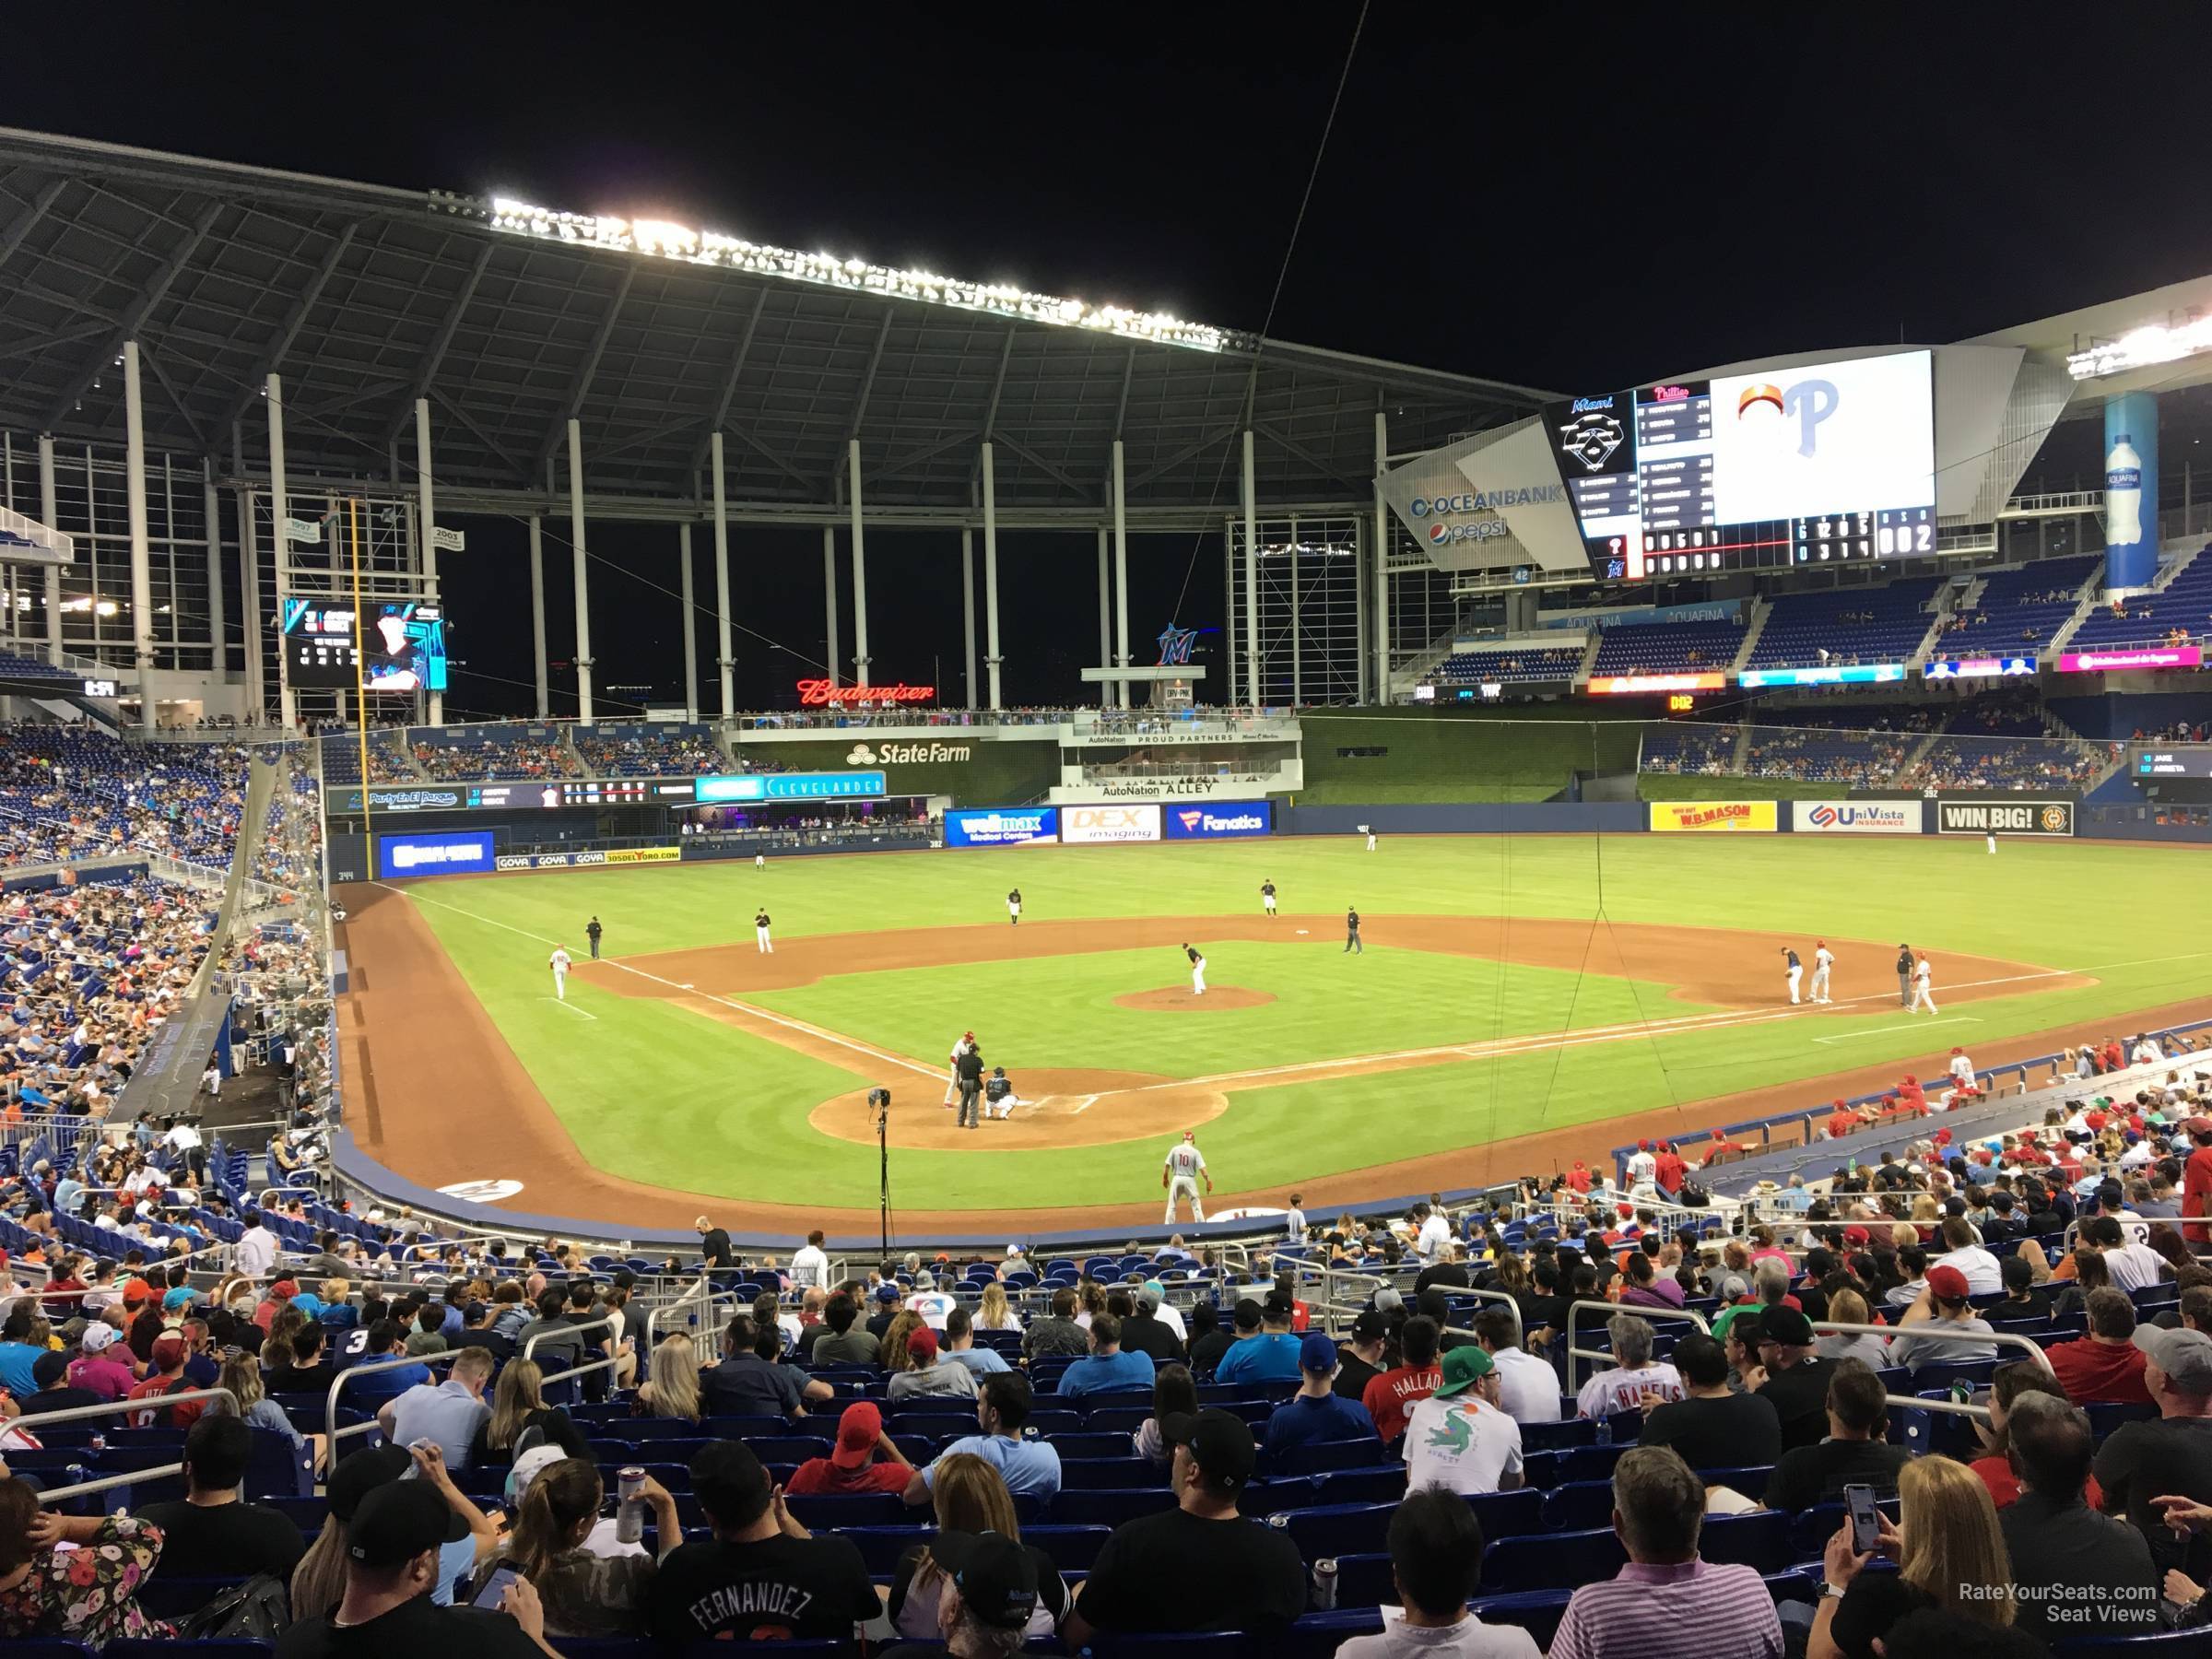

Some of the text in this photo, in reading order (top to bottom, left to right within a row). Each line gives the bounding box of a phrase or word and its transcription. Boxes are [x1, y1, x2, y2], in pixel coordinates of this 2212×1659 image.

[1654, 385, 1689, 402] Phillies
[1571, 396, 1613, 413] Miami
[2108, 474, 2138, 484] AQUAFINA
[1434, 485, 1566, 512] OCEANBANK
[436, 528, 458, 541] 2003
[1451, 518, 1506, 544] pepsi
[1879, 524, 1931, 553] 0 0 2
[1515, 571, 1528, 581] 42
[1669, 607, 1725, 623] QUAFINA
[796, 678, 935, 704] Budweiser
[879, 743, 971, 763] State Farm
[767, 779, 882, 796] CLEVELANDER
[1103, 783, 1214, 796] AutoNation ALLEY
[370, 793, 396, 805] Party
[420, 791, 457, 805] Parque
[1072, 809, 1143, 828] DEX
[1203, 815, 1263, 830] Fanatics
[1838, 807, 1904, 826] UniVista
[1946, 807, 1987, 828] WIN
[1990, 807, 2033, 829] BIG!
[1088, 830, 1152, 840] imaging
[499, 856, 529, 867] GOYA
[538, 854, 567, 865] GOYA
[577, 853, 605, 864] GOYA
[338, 871, 354, 881] 344
[1179, 1154, 1189, 1167] 10
[1645, 1163, 1654, 1175] 19
[346, 1329, 369, 1354] 3
[1393, 1373, 1445, 1398] HALLAD
[688, 1581, 813, 1631] FERNANDEZ
